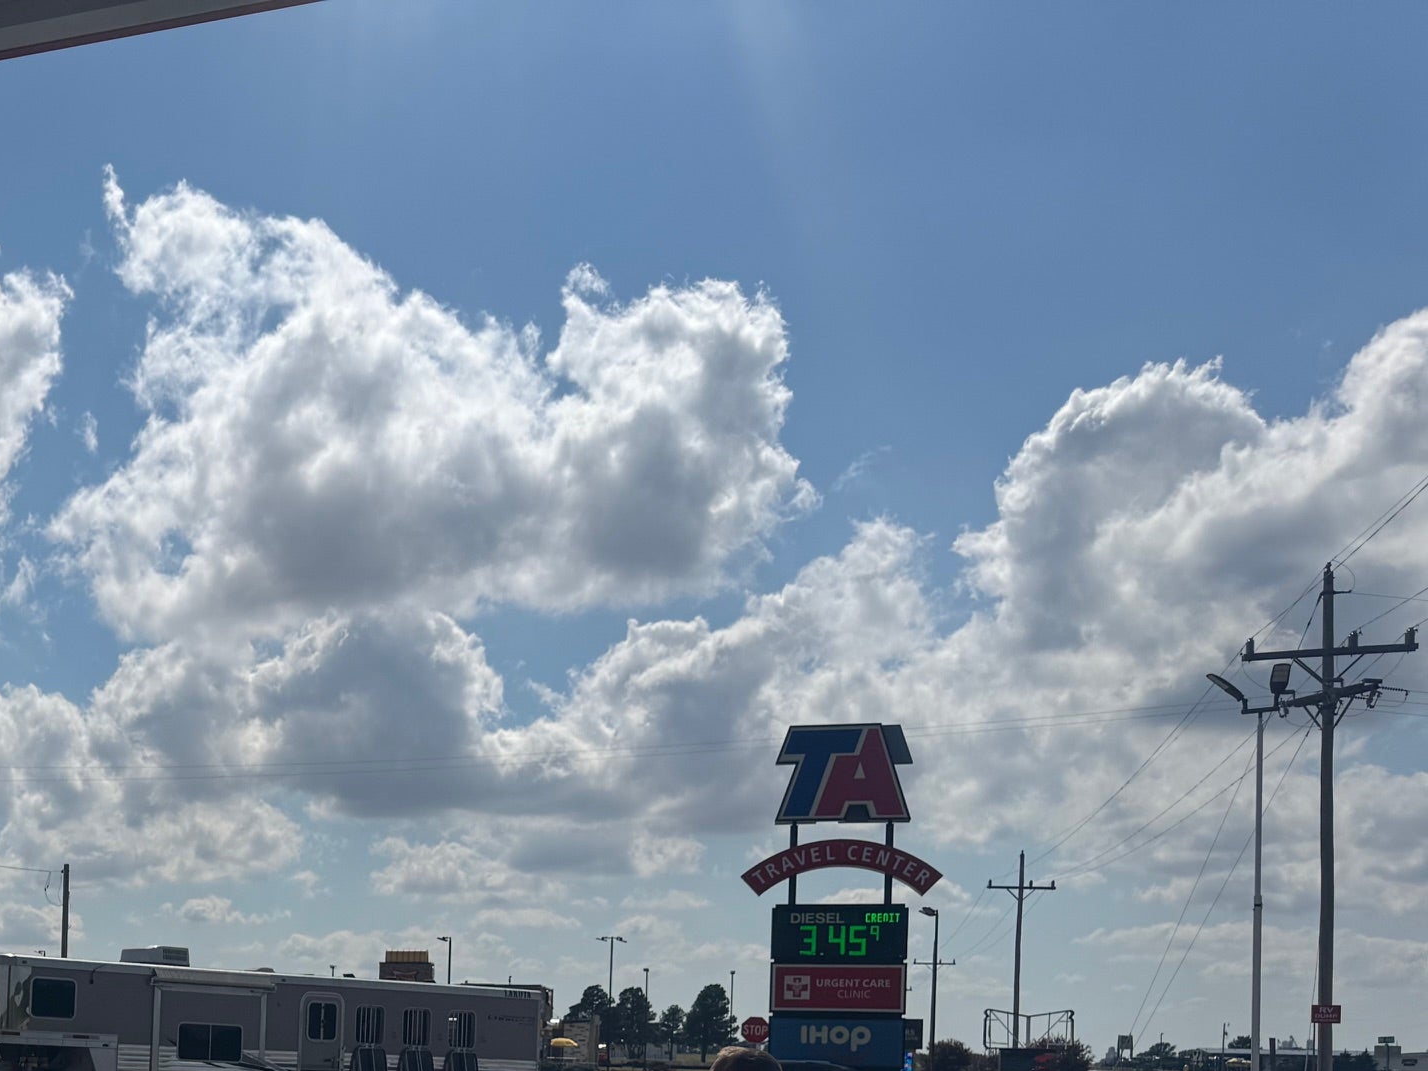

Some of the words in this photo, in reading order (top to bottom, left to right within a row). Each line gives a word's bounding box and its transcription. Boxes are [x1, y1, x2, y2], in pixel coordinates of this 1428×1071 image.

[776, 723, 911, 823] TA
[752, 844, 836, 886] TRAVEL
[847, 844, 931, 887] CENTER
[790, 912, 845, 924] DIESEL
[815, 978, 860, 988] URGENT
[862, 979, 891, 988] CARE
[836, 989, 871, 999] CLINIC
[743, 1024, 769, 1036] STOP
